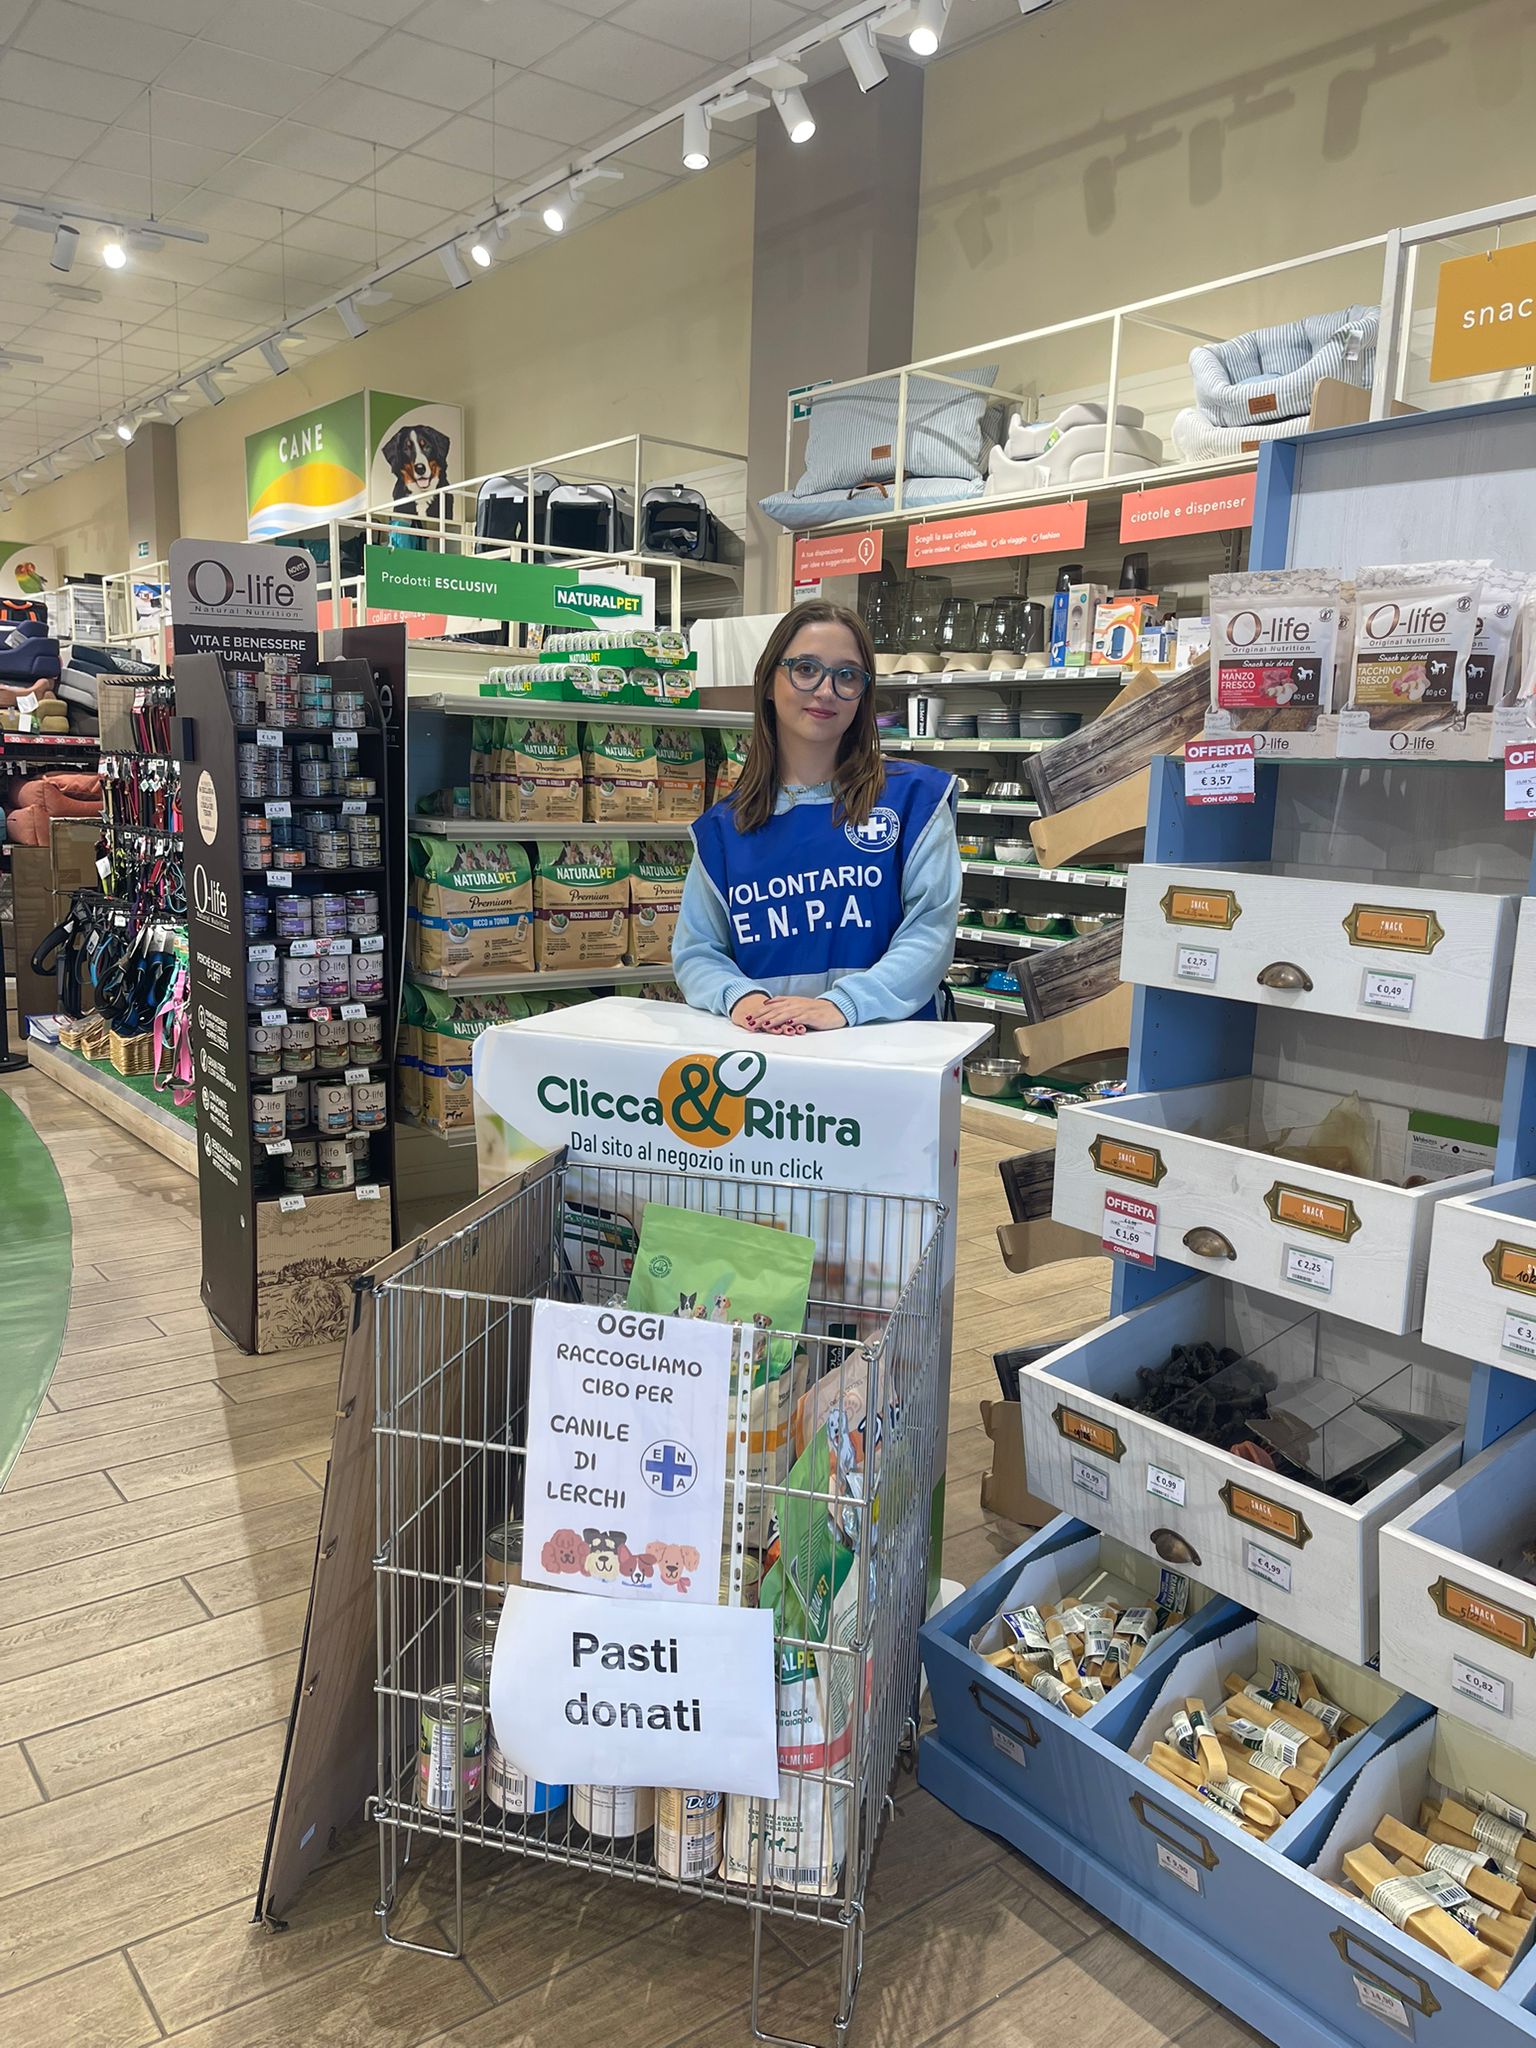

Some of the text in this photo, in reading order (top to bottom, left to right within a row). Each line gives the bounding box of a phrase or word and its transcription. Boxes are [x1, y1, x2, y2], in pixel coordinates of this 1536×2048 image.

[279, 423, 323, 463] CANE
[1131, 497, 1246, 524] ciotole e dispenser
[915, 534, 934, 545] Scegli
[954, 528, 977, 538] ciotola
[187, 560, 295, 606] O-life
[382, 571, 498, 595] Prodotti ESCLUSIVI
[557, 590, 639, 611] NATURALPET
[194, 605, 299, 618] Natural Nutrition
[1226, 611, 1310, 647] O-life
[1365, 603, 1447, 640] O-life
[190, 634, 306, 651] VITA E BENESSERE
[1232, 644, 1311, 654] Original Nutrition
[1369, 636, 1446, 647] Original Nutrition
[1242, 660, 1264, 668] Snack
[1378, 653, 1399, 662] Snack
[1221, 671, 1255, 681] MANZO
[1357, 665, 1402, 676] TACCHINO
[1221, 681, 1256, 690] FRESCO
[1357, 675, 1390, 685] FRESCO
[1389, 732, 1435, 751] O-life
[524, 744, 569, 756] NATURALPET
[605, 746, 645, 758] NATURALPET
[1188, 743, 1253, 758] OFFERTA
[1201, 775, 1233, 787] € 3,57
[1526, 787, 1534, 798] €
[453, 871, 517, 887] NATURALPET
[556, 867, 617, 880] NATURALPET
[193, 864, 228, 918] O-life
[569, 889, 609, 902] Premium
[469, 895, 512, 909] Premium
[1190, 900, 1210, 912] SNACK
[570, 911, 584, 919] RICCO
[589, 910, 609, 919] AGNELLO
[732, 894, 872, 944] E. N. P. A.
[1380, 920, 1404, 934] SNACK
[1192, 957, 1208, 967] 2,75
[1377, 984, 1402, 996] € 0,49
[536, 1055, 861, 1148] Clicca & Ritira
[571, 1131, 824, 1181] Dal sito al negozio in un click
[1118, 1152, 1136, 1166] SNACK
[1106, 1196, 1155, 1220] OFFERTA
[1302, 1204, 1324, 1220] SNACK
[1115, 1228, 1140, 1243] € 1,69
[1113, 1245, 1140, 1260] CON CARD
[1297, 1259, 1321, 1273] € 2,25
[597, 1313, 665, 1342] OGGI
[1517, 1327, 1524, 1336] €
[556, 1343, 703, 1378] RACCOGLIAMO
[582, 1377, 673, 1404] CIBO PER
[550, 1414, 630, 1443] CANILE
[574, 1451, 597, 1472] DI
[653, 1448, 687, 1463] E N
[651, 1474, 686, 1489] P A
[1156, 1475, 1177, 1490] € 0,99
[546, 1480, 627, 1510] LERCHI
[1250, 1500, 1272, 1518] SNACK
[1264, 1561, 1281, 1575] 4,99
[1470, 1603, 1496, 1625] SNACK
[572, 1631, 679, 1674] Pasti
[1465, 1673, 1493, 1693] € 0,82
[564, 1692, 702, 1733] donati
